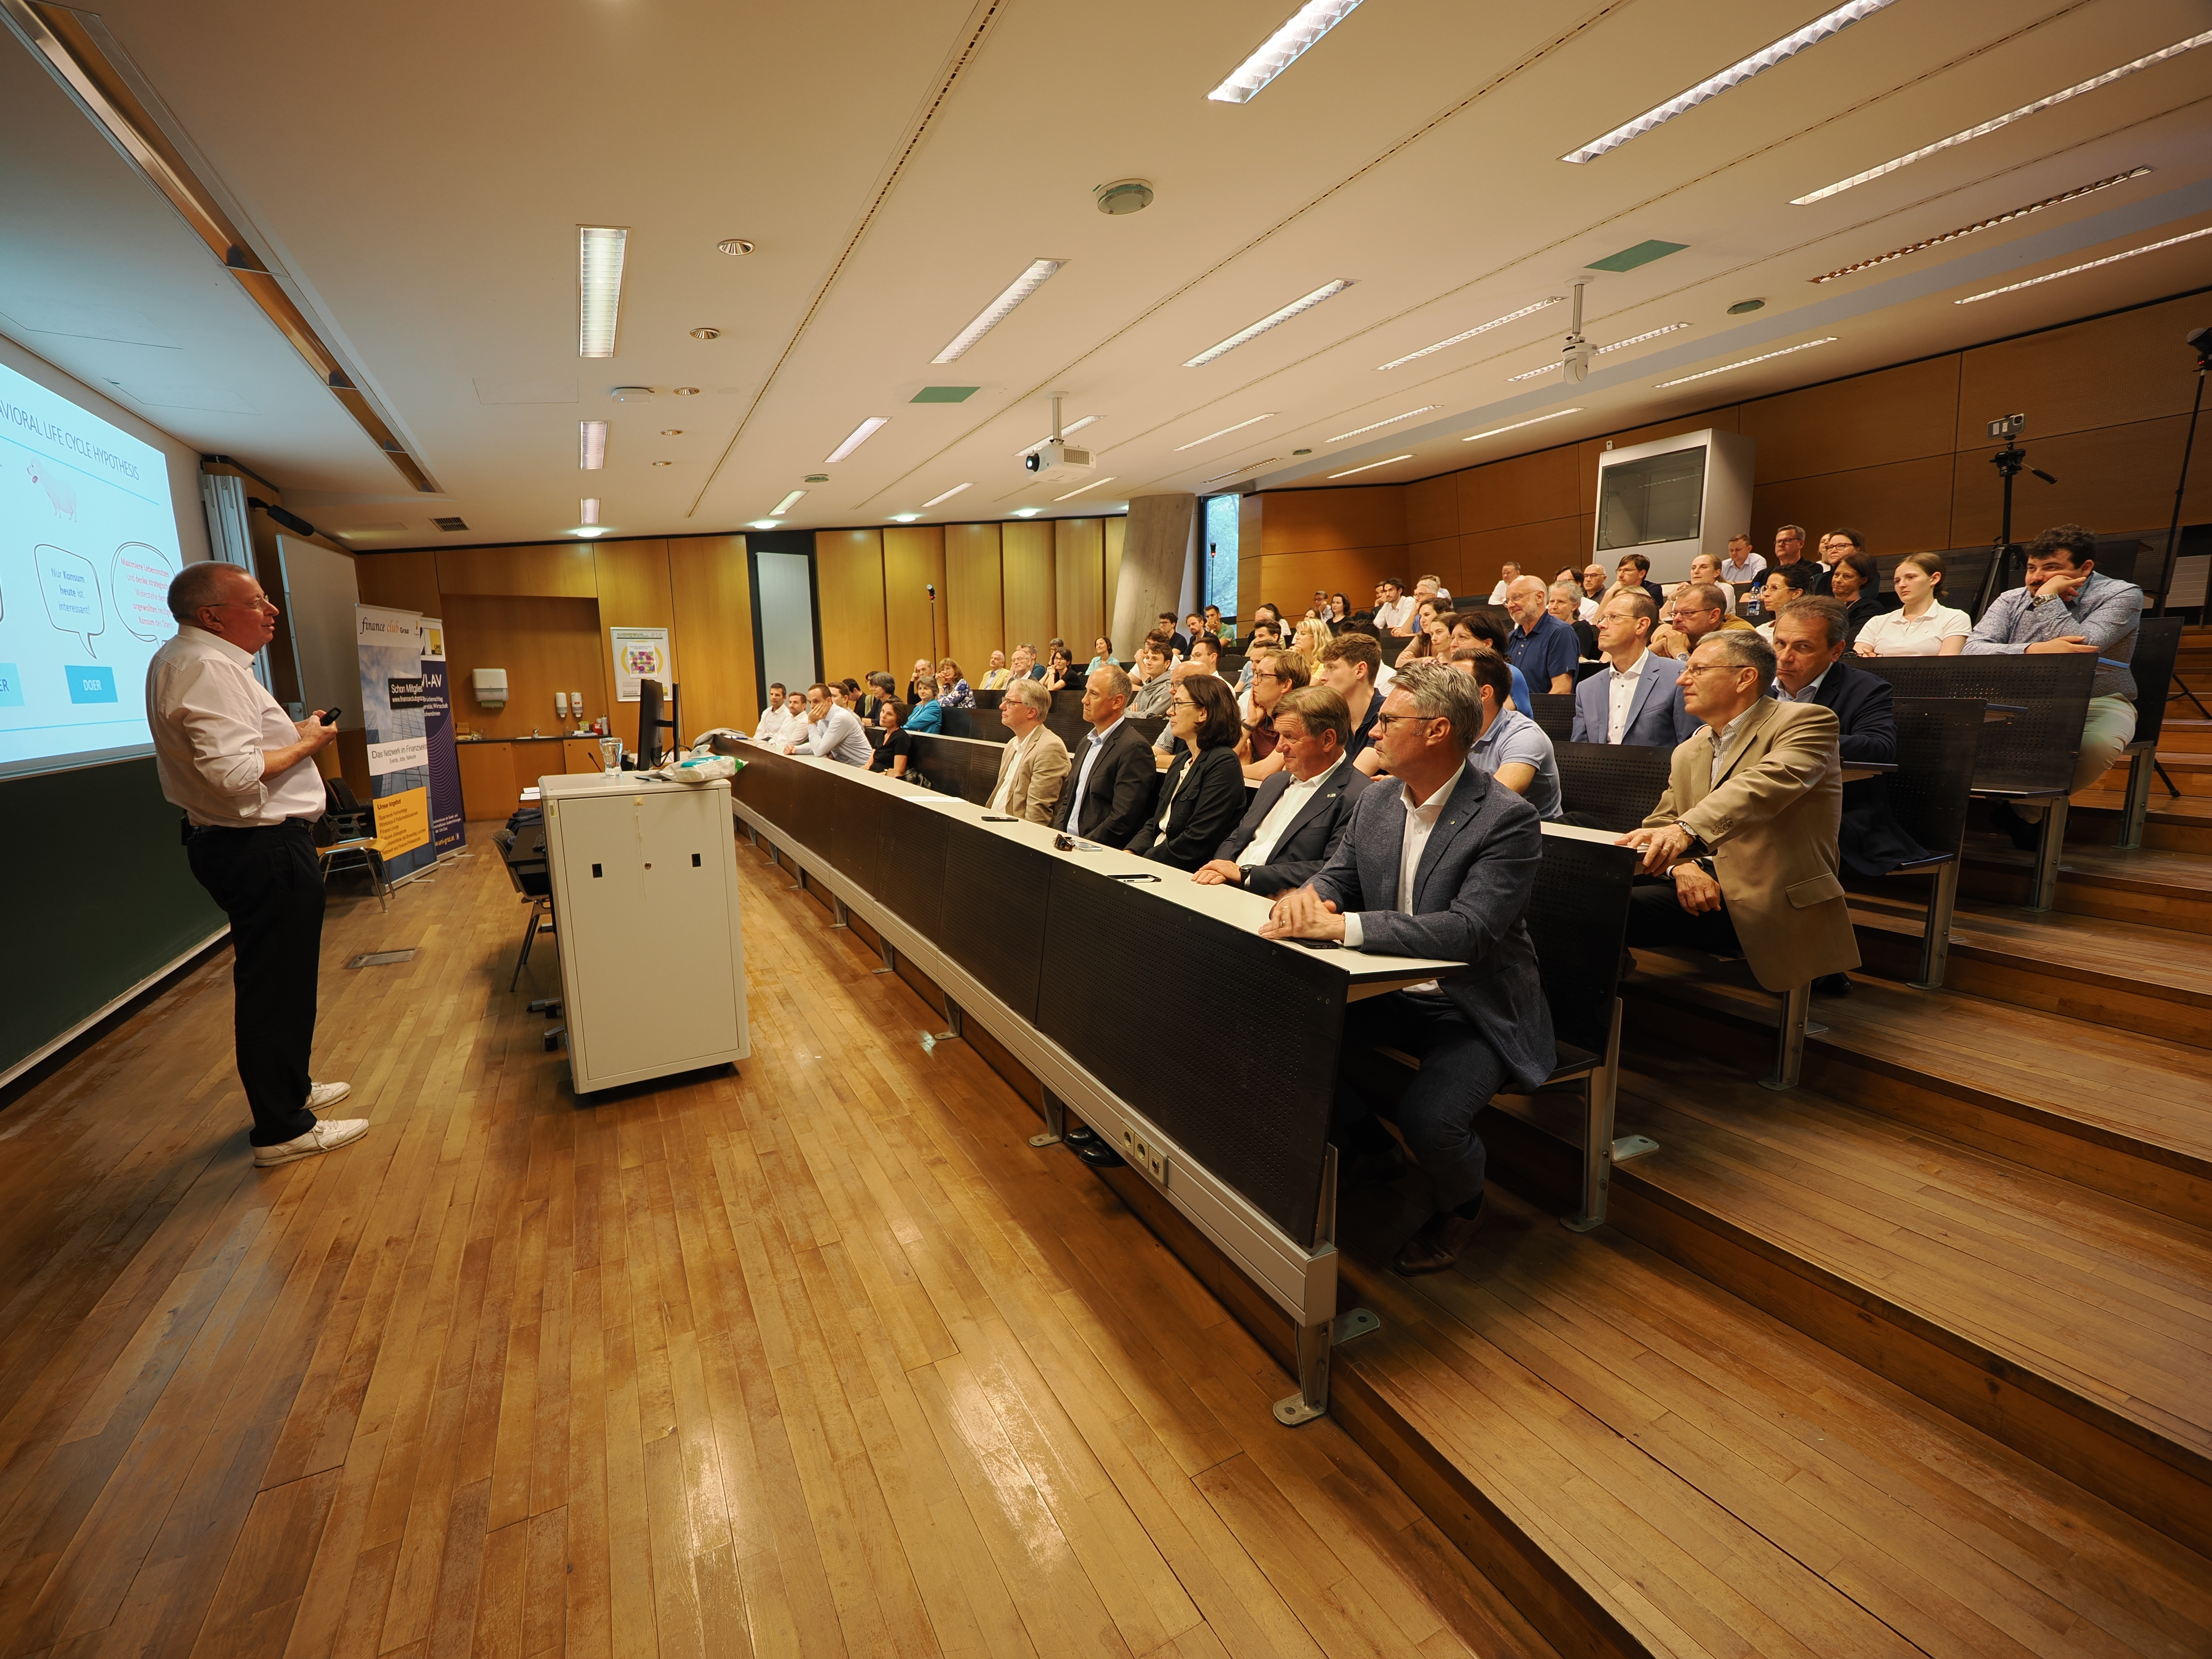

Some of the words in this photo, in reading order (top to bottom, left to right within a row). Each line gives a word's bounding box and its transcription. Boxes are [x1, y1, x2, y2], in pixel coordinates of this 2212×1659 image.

[0, 400, 43, 436] AVIORAL
[44, 421, 64, 445] LIFE
[65, 432, 92, 459] CYCLE
[93, 445, 139, 480] HYPOTHESIS
[121, 557, 143, 570] Maximiere
[144, 563, 169, 578] Lebensnutzen
[51, 568, 61, 578] Nur
[62, 570, 85, 583] Konsum
[127, 573, 135, 582] und
[136, 574, 148, 585] denke
[59, 585, 76, 597] heute
[135, 588, 157, 600] Widerstehe
[158, 593, 167, 602] dem
[58, 601, 90, 615] interessant!
[133, 603, 157, 613] ungewollten
[157, 605, 173, 617] heutige
[138, 616, 155, 626] Konsum
[162, 620, 173, 629] Doers
[360, 617, 385, 634] finance
[387, 620, 399, 633] club
[0, 679, 9, 692] ER
[83, 679, 102, 691] DOER
[422, 673, 442, 688] I-AV
[391, 684, 405, 694] Schon
[372, 751, 383, 759] Das
[383, 747, 400, 757] Netzwerk
[406, 742, 427, 754] Finanzsekt
[389, 799, 402, 807] Angebot
